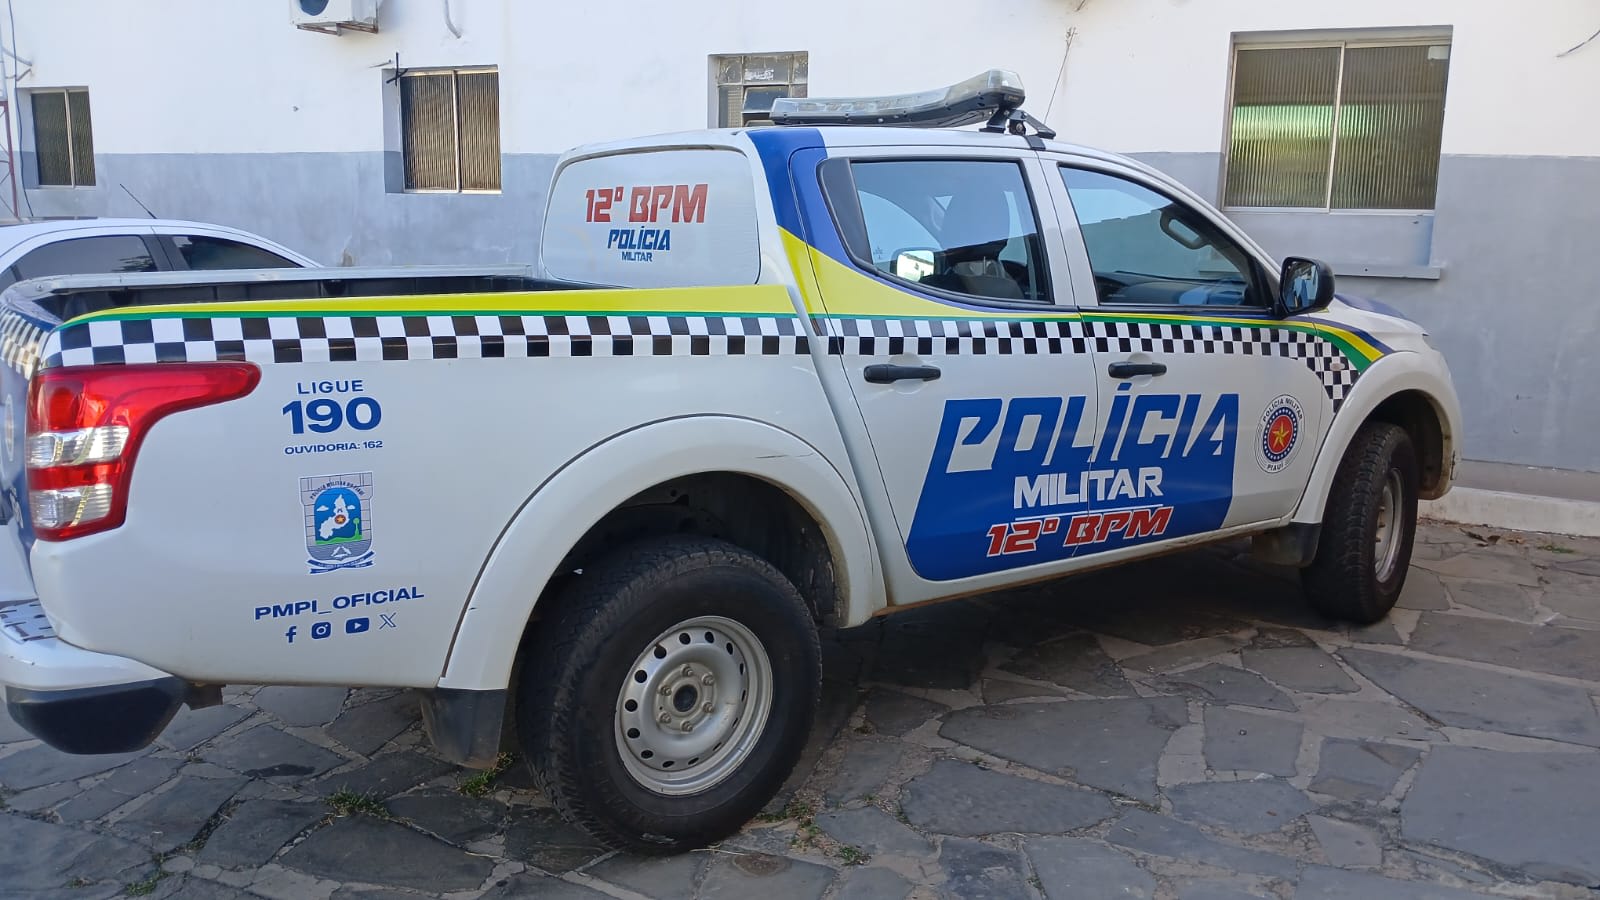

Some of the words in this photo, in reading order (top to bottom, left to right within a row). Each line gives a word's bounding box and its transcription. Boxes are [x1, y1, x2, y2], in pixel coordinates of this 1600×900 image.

[629, 184, 708, 223] BPM
[607, 225, 671, 250] POLÍCIA
[621, 251, 653, 262] MILITAR
[297, 380, 364, 395] LIGUE
[282, 396, 382, 434] 190
[928, 382, 1240, 473] POLÍCIA
[284, 442, 361, 455] OUVIDORIA:
[363, 440, 383, 450] 162
[1013, 466, 1164, 509] MILITAR
[1063, 506, 1174, 547] BPM
[255, 586, 425, 620] PMPI_OFICIAL
